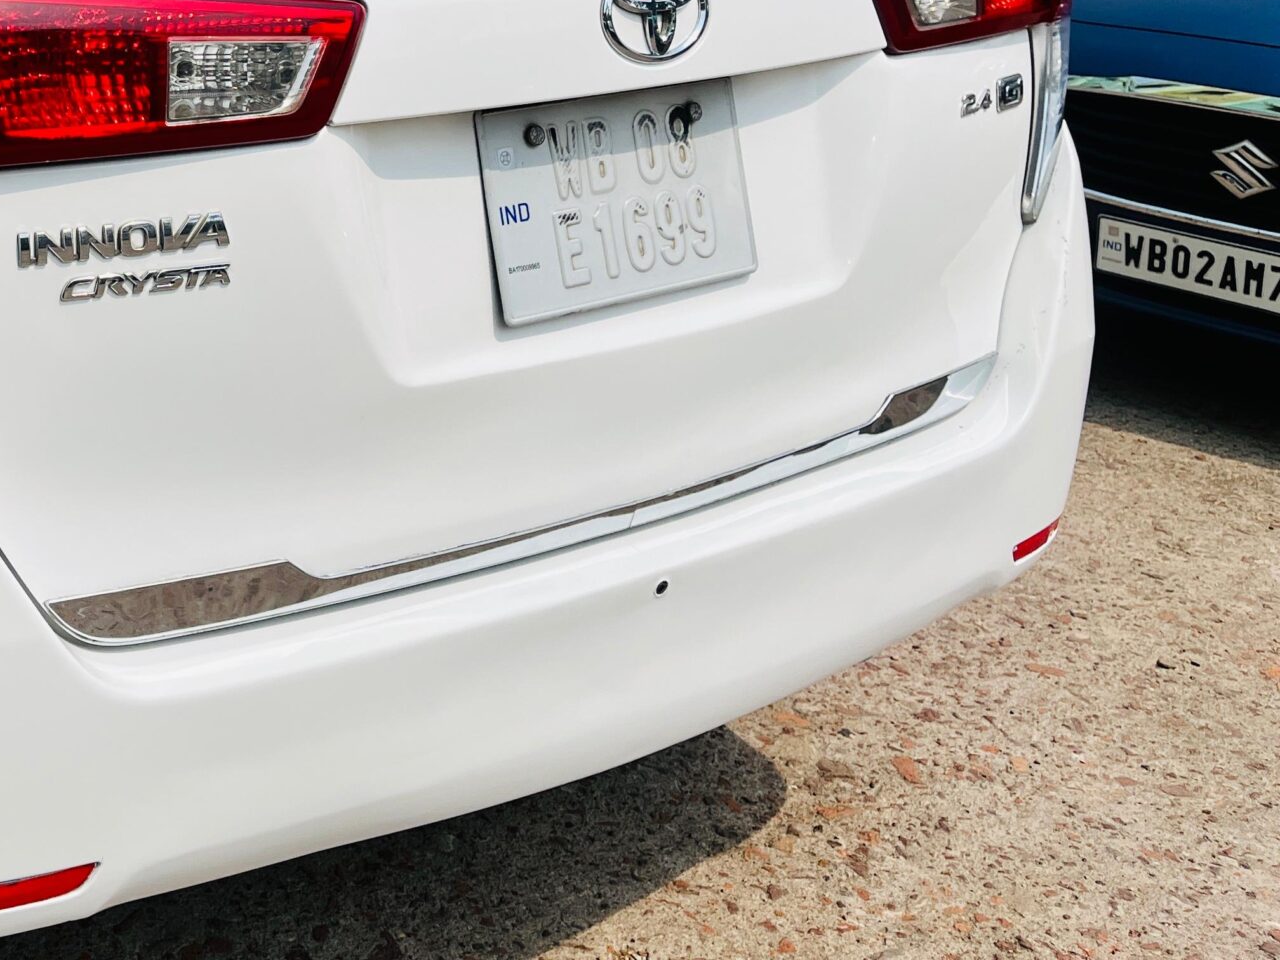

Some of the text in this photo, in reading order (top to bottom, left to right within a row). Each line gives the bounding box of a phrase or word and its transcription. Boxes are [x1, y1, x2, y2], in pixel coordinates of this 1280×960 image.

[547, 104, 697, 200] WB 08
[499, 203, 530, 226] IND
[553, 184, 717, 289] E1699
[17, 211, 231, 268] INNOVA
[1103, 239, 1122, 252] IND
[60, 263, 231, 303] CRYSTA
